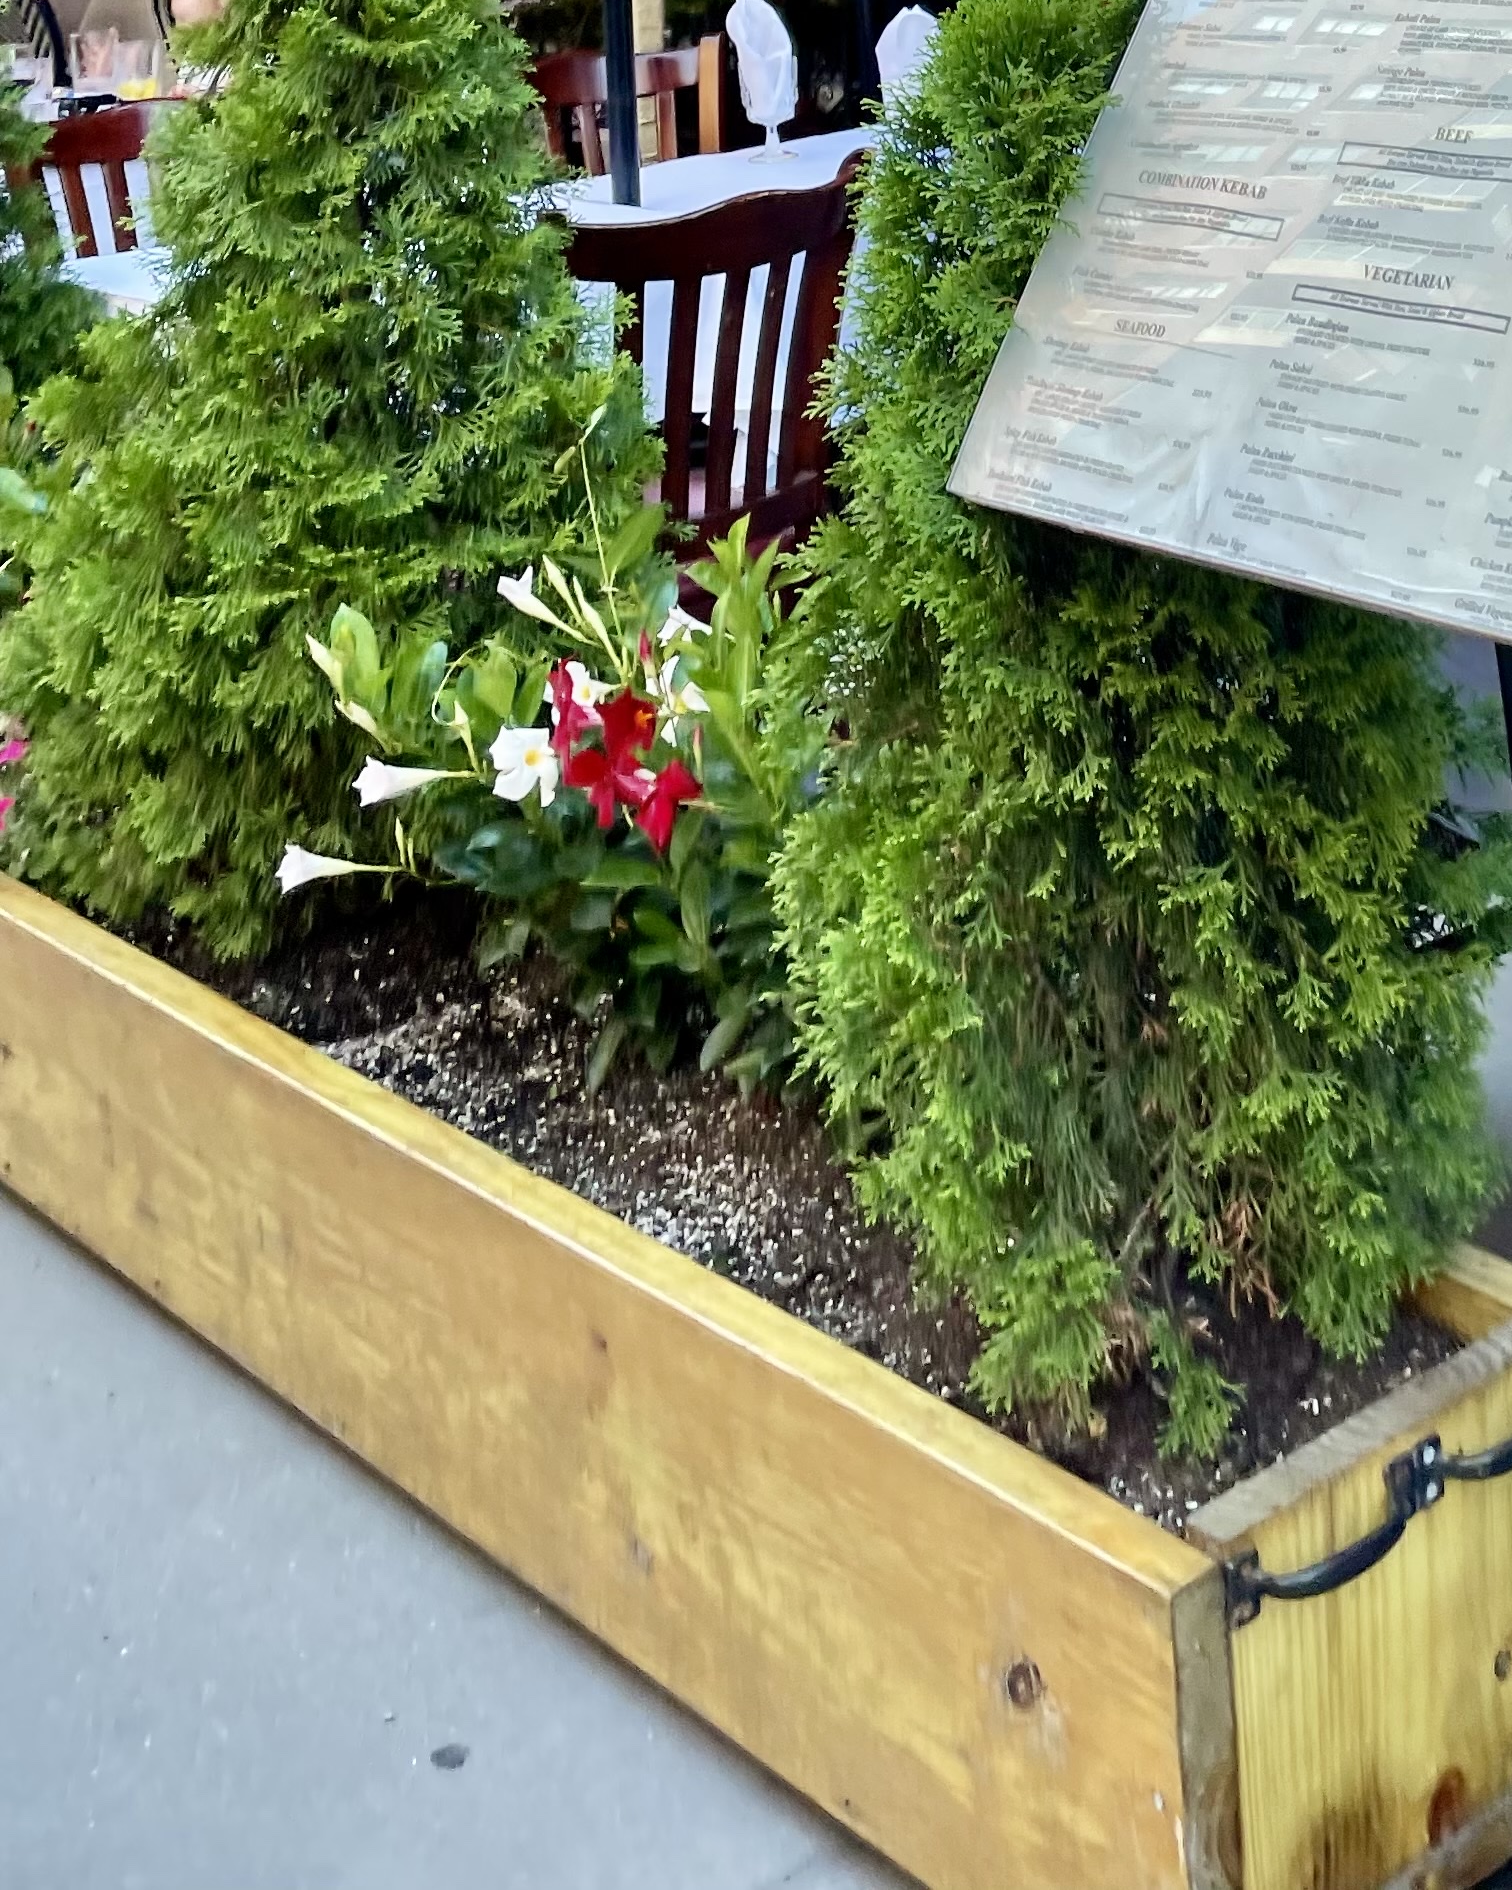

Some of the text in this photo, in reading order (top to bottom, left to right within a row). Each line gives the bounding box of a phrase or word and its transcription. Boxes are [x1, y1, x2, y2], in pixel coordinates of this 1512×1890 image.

[1435, 127, 1474, 143] BEEF
[1138, 170, 1267, 199] COMBINATION KEBAB
[1364, 264, 1455, 290] VEGETARIAN
[1114, 319, 1166, 337] SEAFOOD
